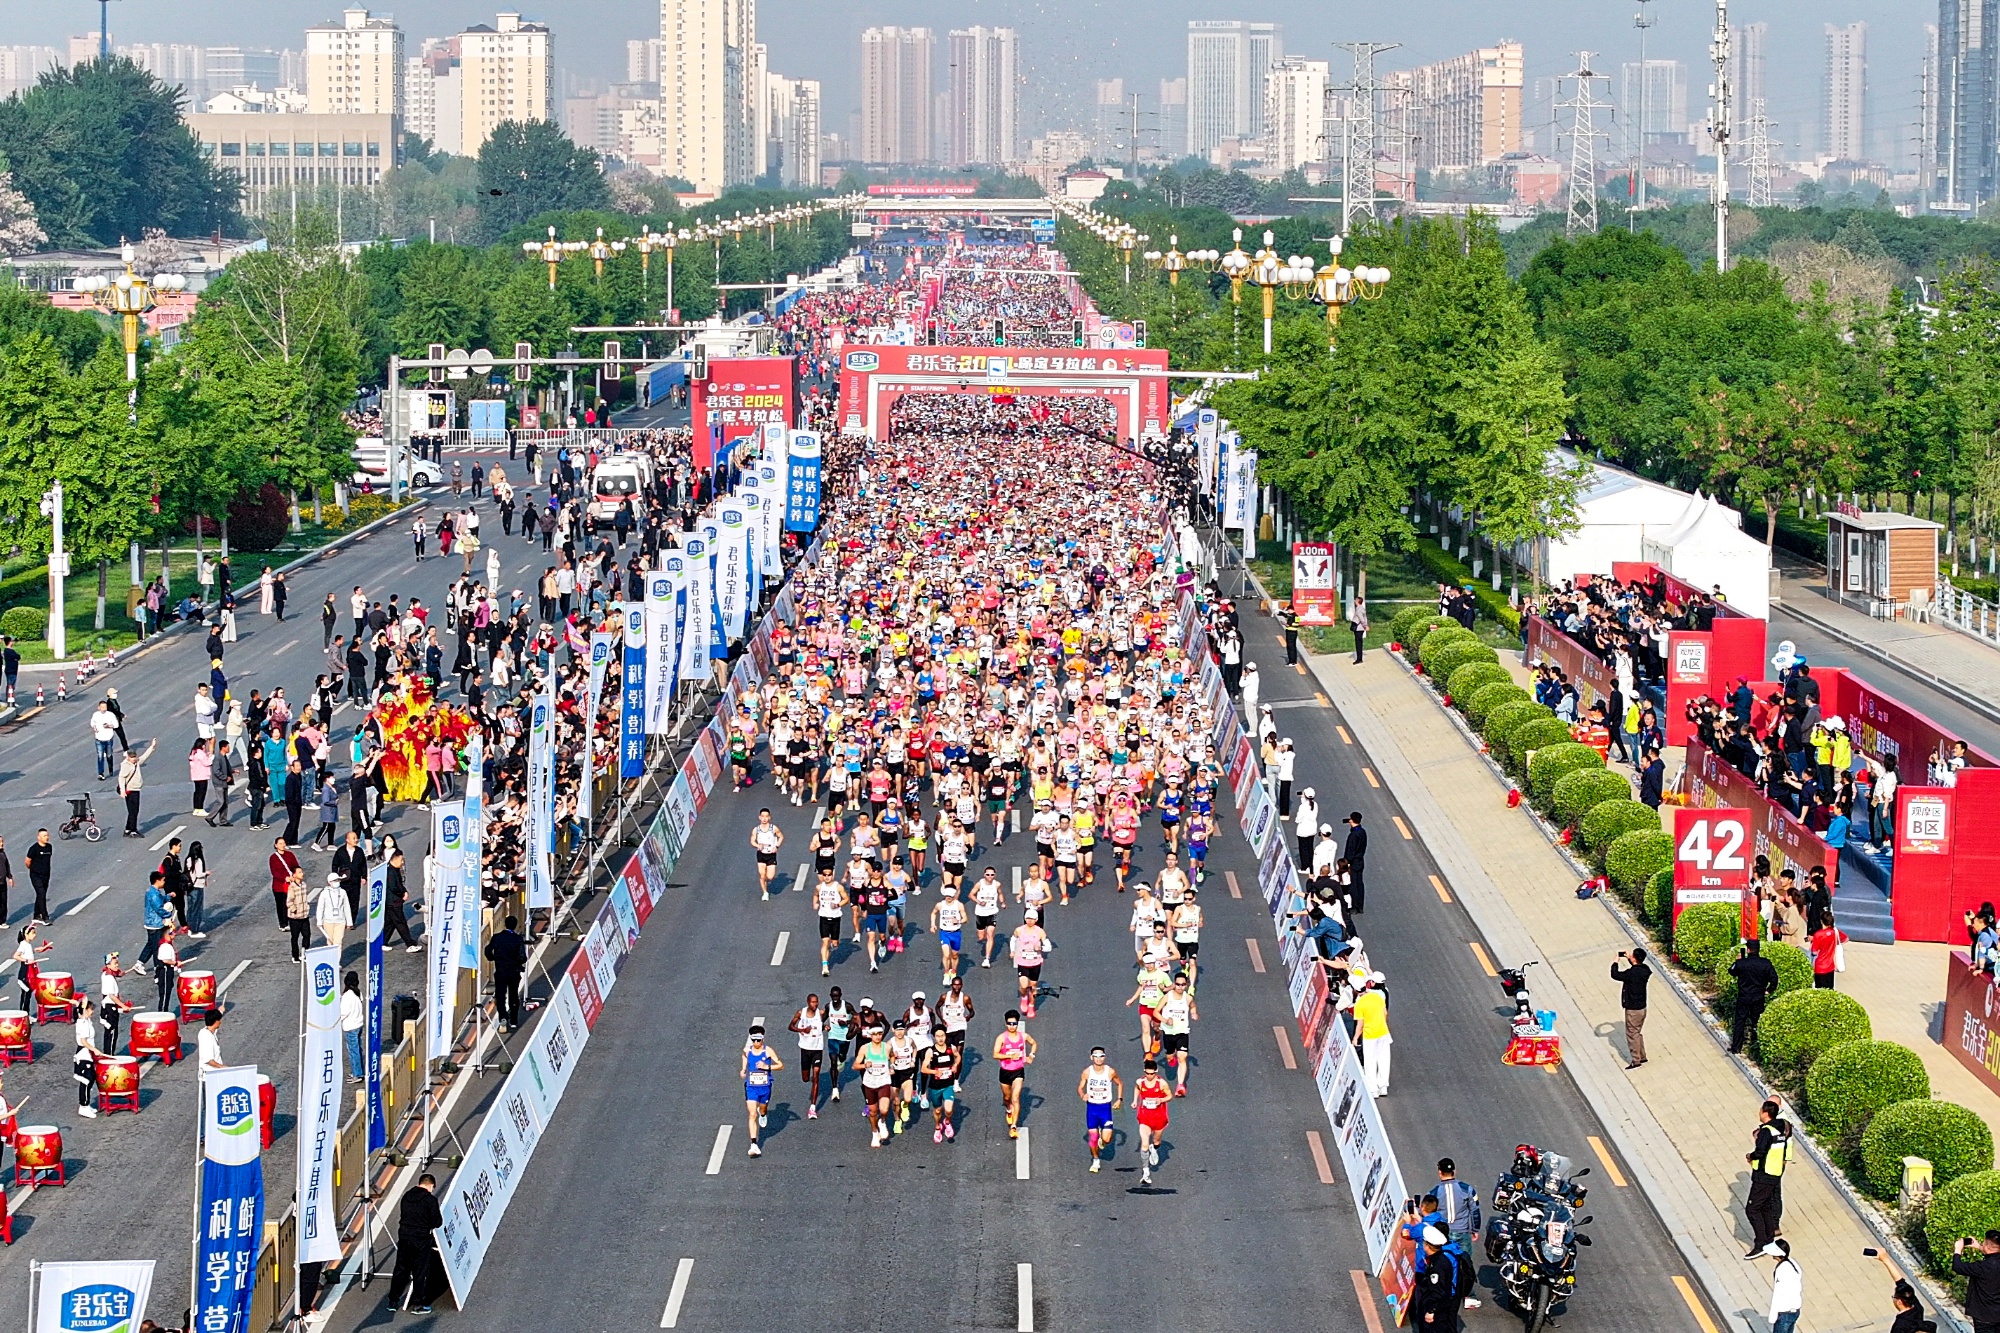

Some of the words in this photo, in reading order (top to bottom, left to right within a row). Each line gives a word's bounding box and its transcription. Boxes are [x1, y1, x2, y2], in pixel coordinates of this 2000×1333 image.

[1102, 327, 1113, 340] 60
[705, 394, 784, 408] 君乐宝2024
[790, 465, 804, 522] 科学营养
[804, 466, 818, 523] 鲜活力量
[1299, 546, 1328, 555] 100m
[722, 545, 738, 627] 君乐宝集团
[691, 579, 703, 669] 君乐宝集团
[627, 664, 638, 760] 科学营养
[1911, 806, 1942, 817] 观摩区
[1912, 820, 1940, 836] B区
[1678, 819, 1745, 870] 42
[1701, 875, 1722, 886] km
[314, 968, 335, 989] 君乐宝
[1962, 1010, 2000, 1081] 君乐宝20
[220, 1092, 250, 1115] 君乐宝
[304, 1049, 335, 1240] 君乐宝集团
[71, 1292, 130, 1319] 君乐宝
[70, 1318, 108, 1328] JUNLEBAO
